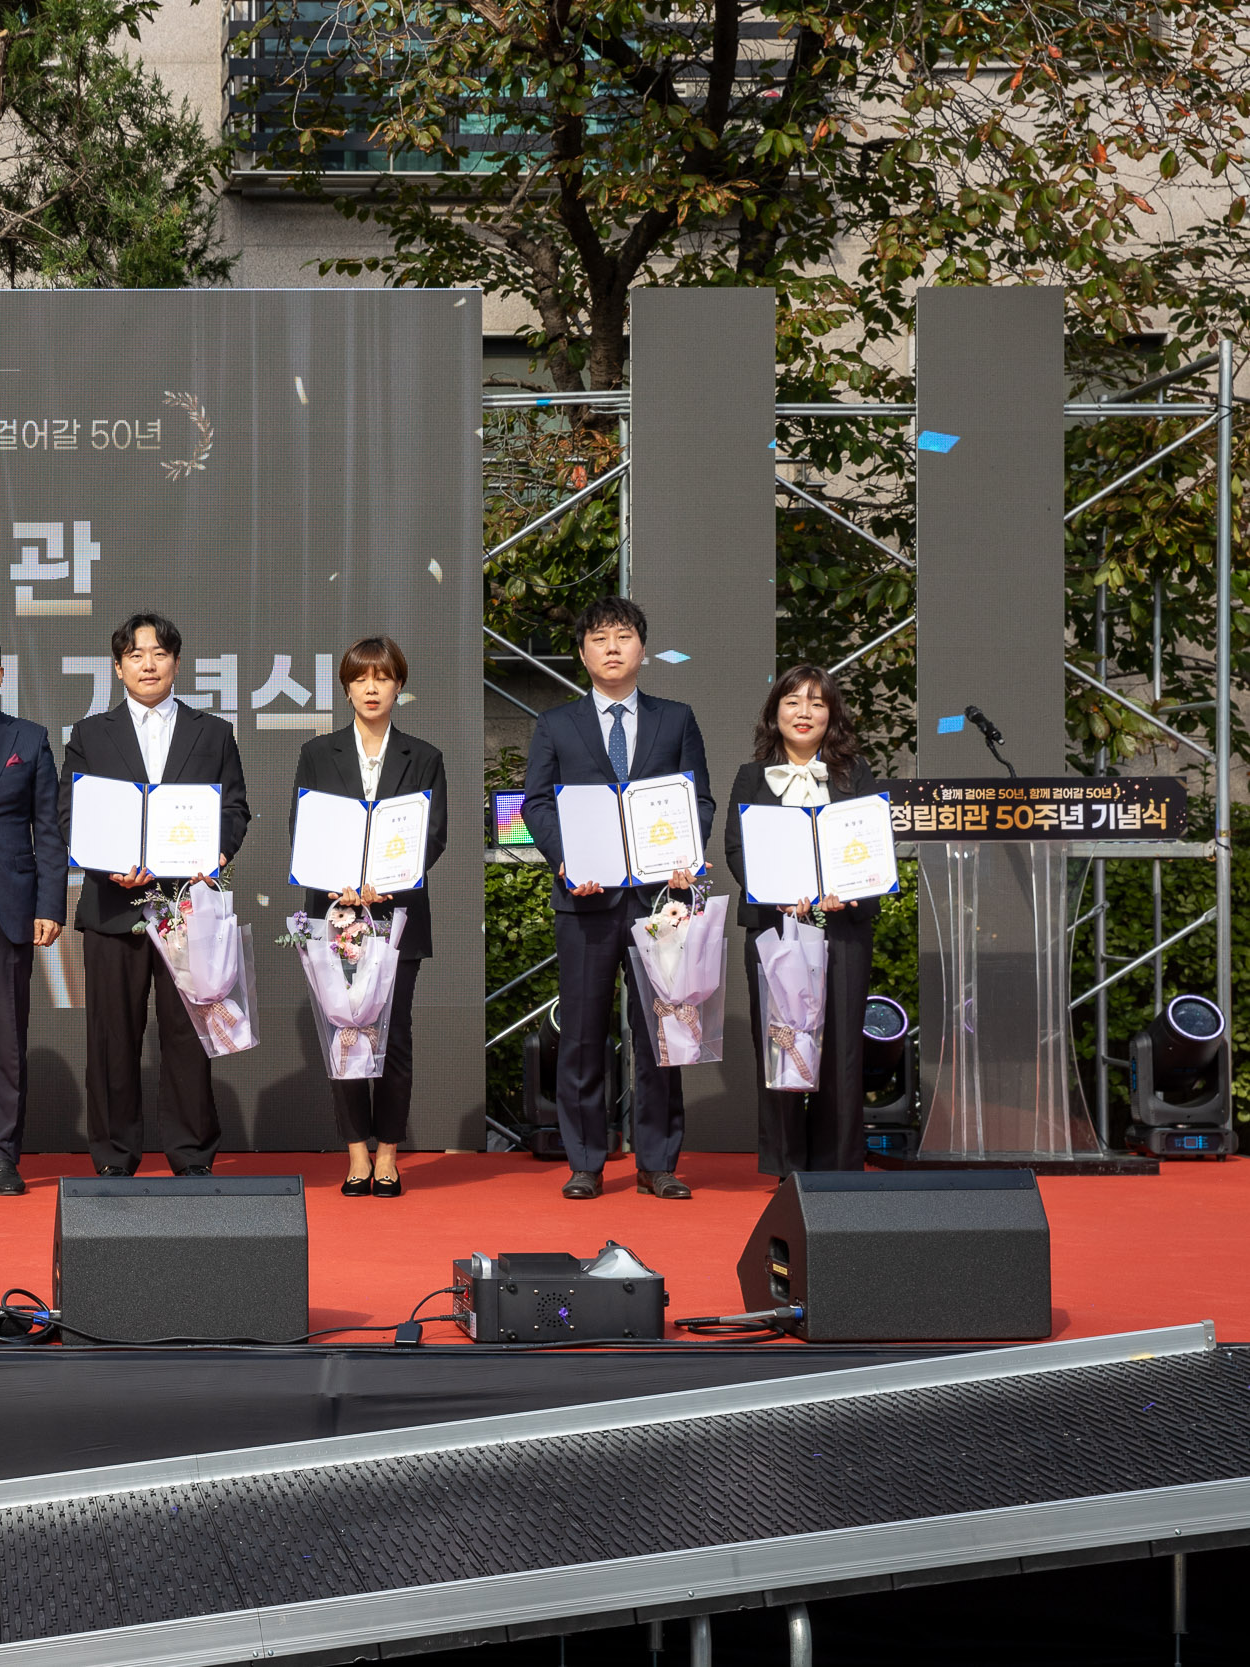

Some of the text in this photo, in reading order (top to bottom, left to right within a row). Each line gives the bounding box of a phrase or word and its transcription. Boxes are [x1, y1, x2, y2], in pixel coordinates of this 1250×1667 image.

[91, 419, 162, 452] 50년
[941, 787, 1112, 801] 함께 걸어온 50년, 함께 걸어갈 50년
[890, 802, 1167, 832] 정립회관 50주년 기념식
